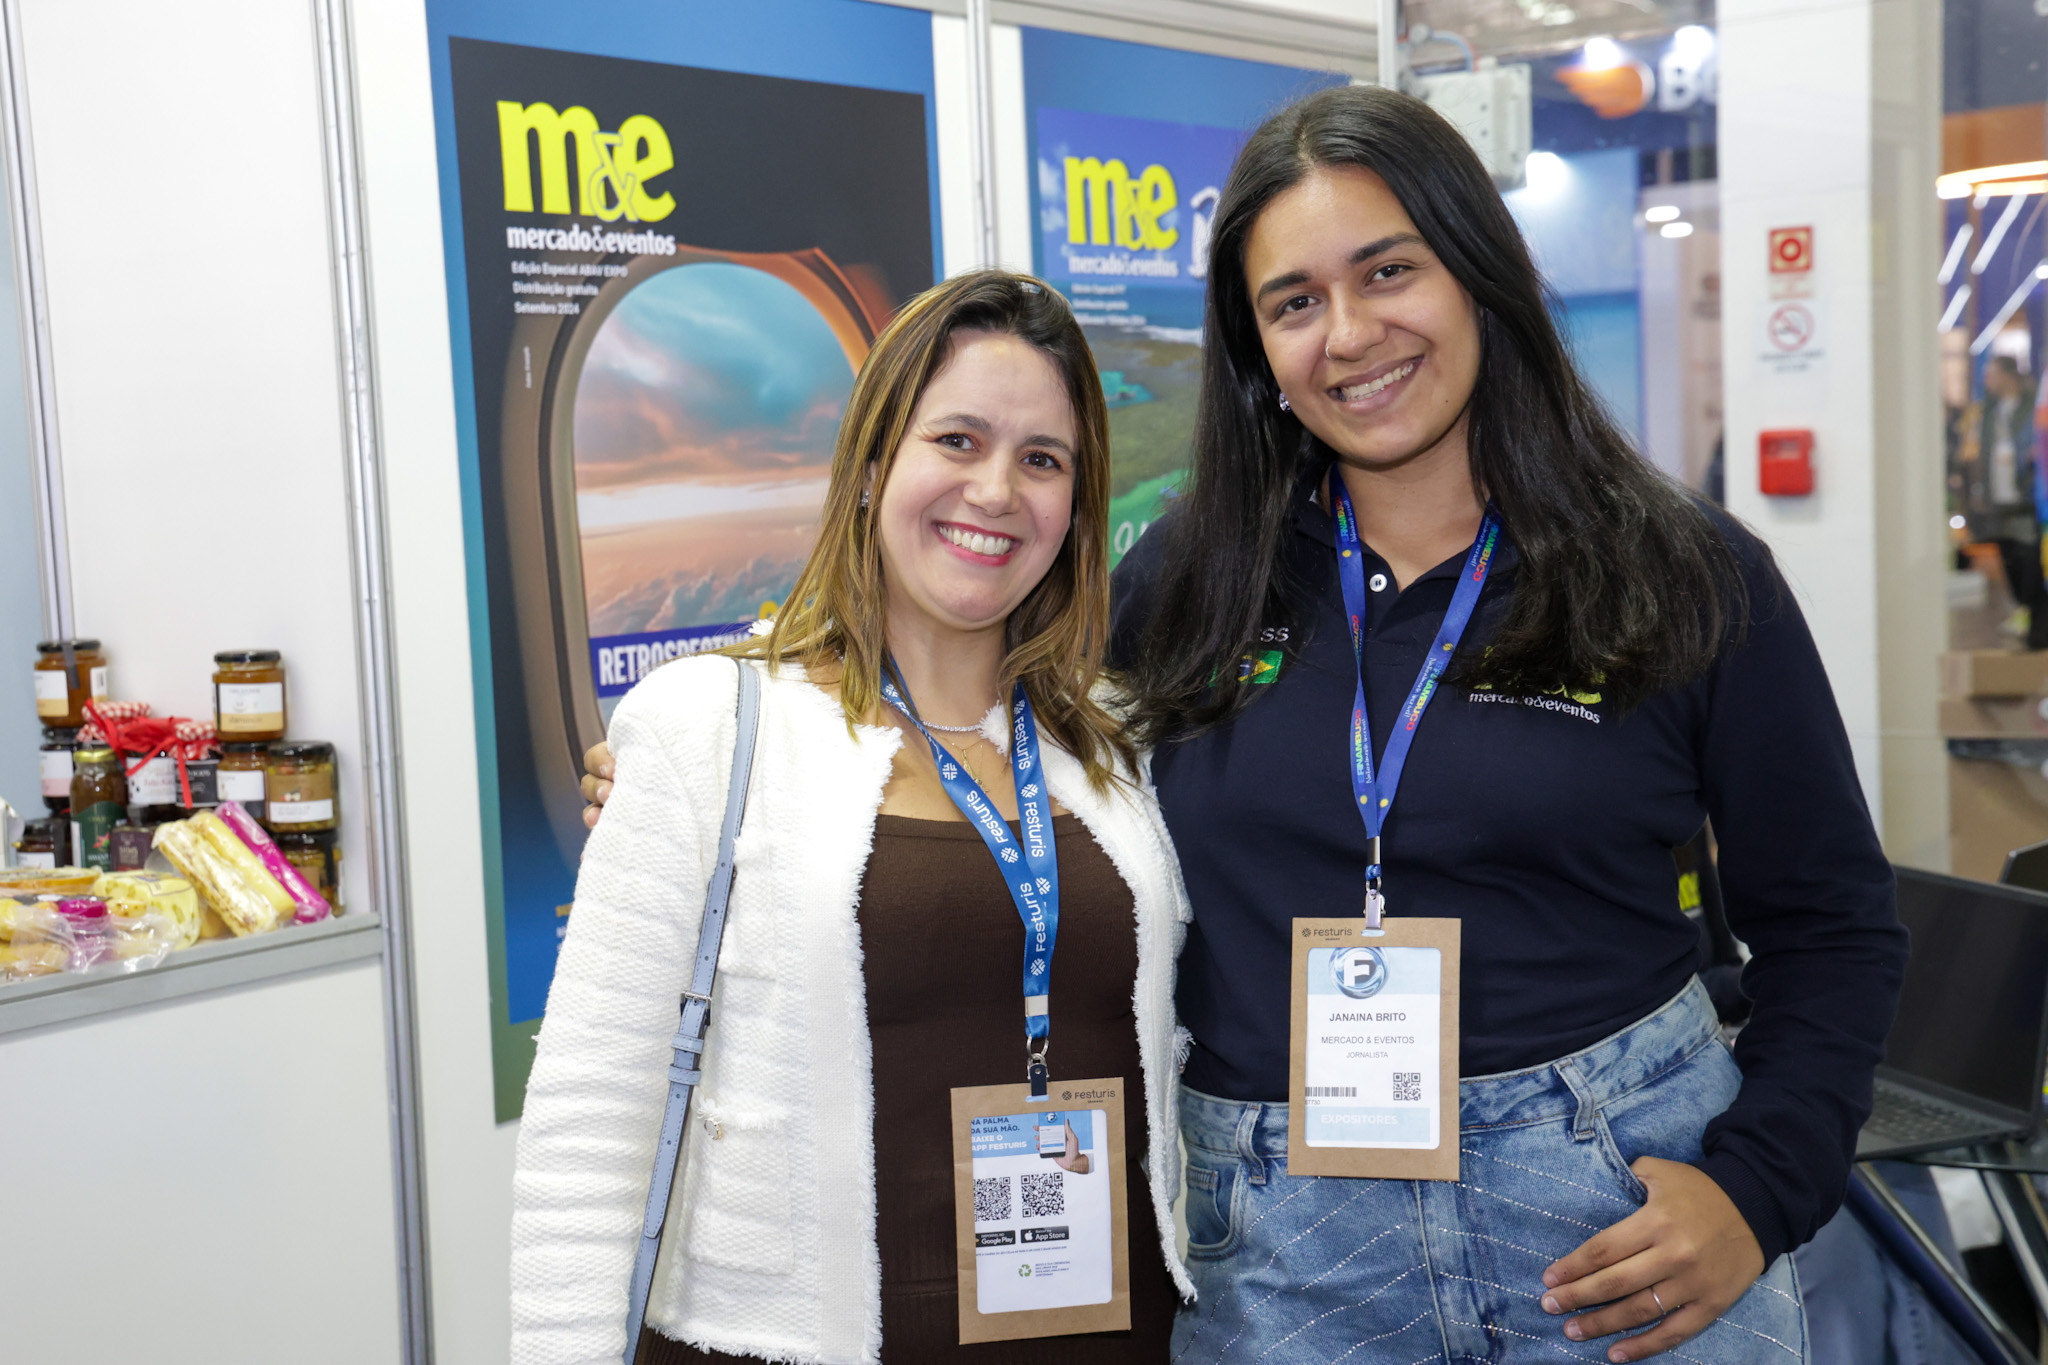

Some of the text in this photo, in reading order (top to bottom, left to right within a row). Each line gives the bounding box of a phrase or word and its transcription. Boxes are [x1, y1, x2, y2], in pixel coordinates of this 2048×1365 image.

[496, 100, 677, 222] m&e
[1064, 156, 1179, 251] m&e
[506, 223, 677, 256] mercado&eventos
[511, 260, 541, 276] Edição
[513, 281, 599, 298] Distribuição gratuita
[514, 301, 557, 314] Setembro
[1014, 716, 1031, 770] Festuris
[966, 790, 1009, 843] Festuris
[1024, 802, 1047, 857] Festuris
[1020, 882, 1046, 952] Festuris
[1313, 928, 1352, 937] Festuris
[1329, 1012, 1407, 1022] JANAINA BRITO
[1321, 1036, 1415, 1044] MERCADO & EVENTOS
[1074, 1089, 1116, 1099] Festuris
[1321, 1114, 1398, 1125] EXPOSITORES
[989, 1141, 1027, 1150] FESTURIS
